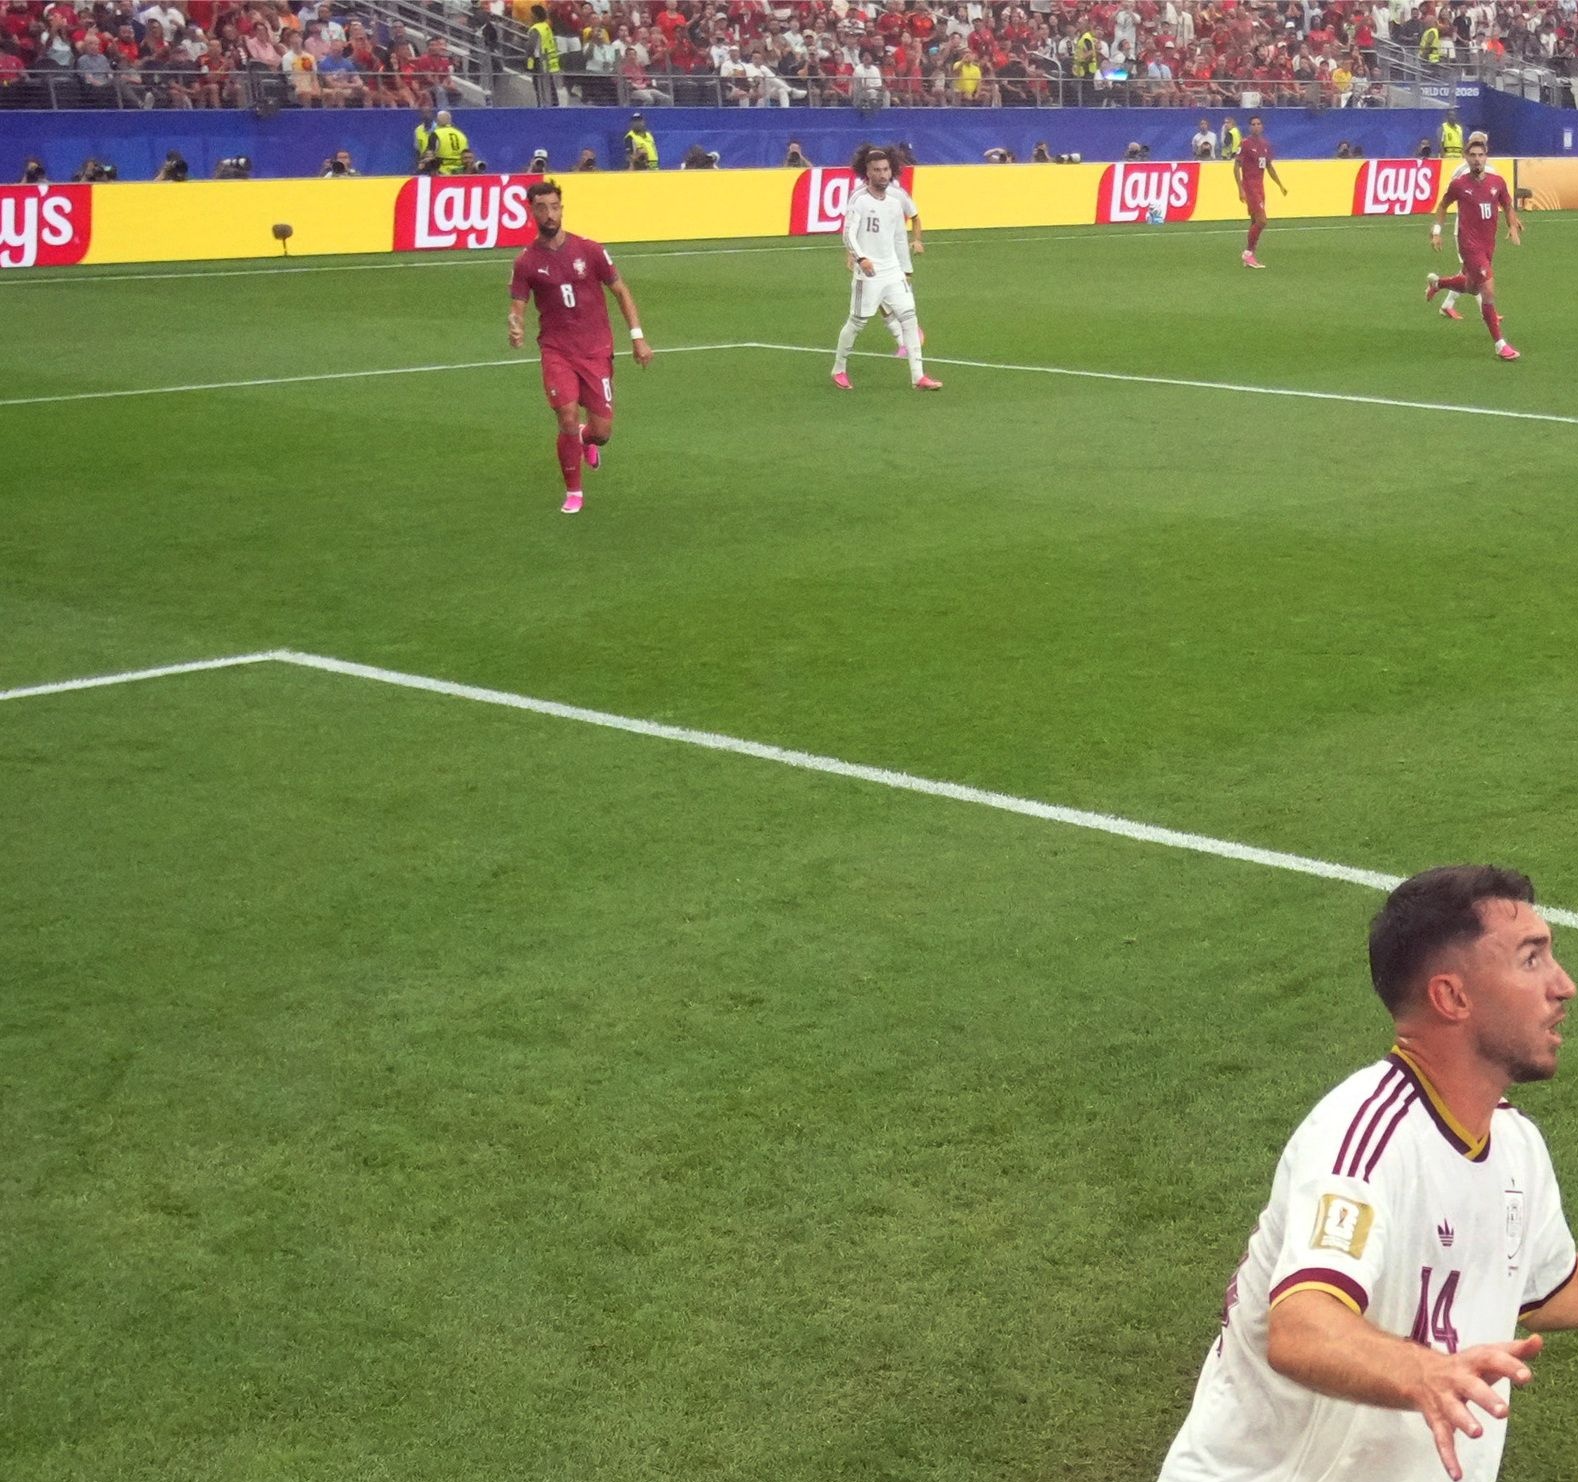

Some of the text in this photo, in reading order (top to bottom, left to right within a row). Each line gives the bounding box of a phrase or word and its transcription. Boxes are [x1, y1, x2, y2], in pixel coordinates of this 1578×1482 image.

[1455, 87, 1480, 97] 2026
[414, 175, 528, 249] Lay's
[1110, 162, 1189, 223] Lay's
[1364, 159, 1432, 215] Lay's
[866, 216, 880, 233] 15
[560, 284, 576, 308] 8
[1405, 1266, 1461, 1354] 14
